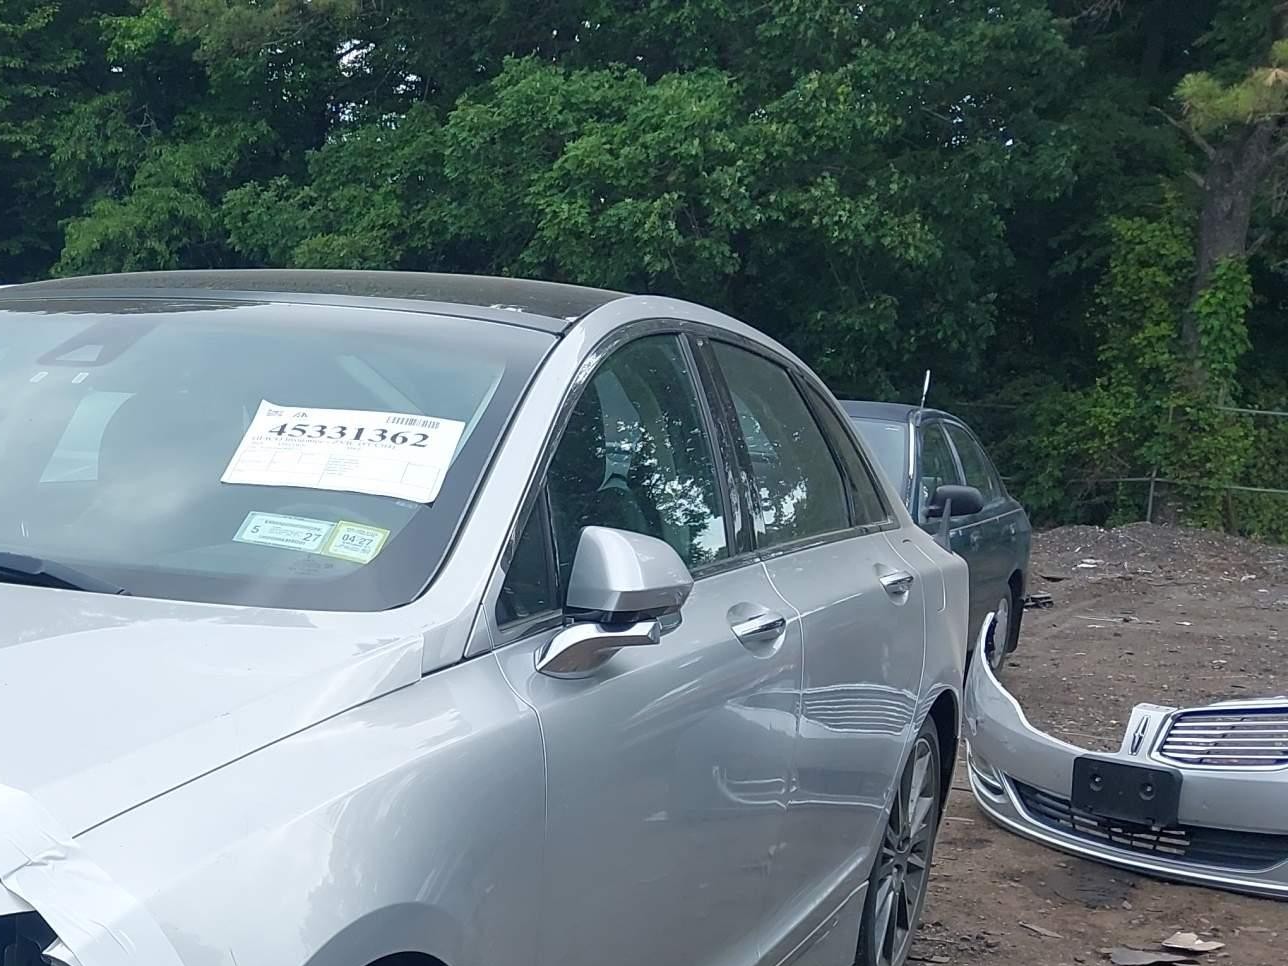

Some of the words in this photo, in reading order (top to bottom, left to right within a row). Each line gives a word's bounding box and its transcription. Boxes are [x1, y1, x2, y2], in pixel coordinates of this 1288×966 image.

[268, 422, 430, 448] 45331362
[251, 525, 261, 534] 5
[303, 532, 322, 542] 27
